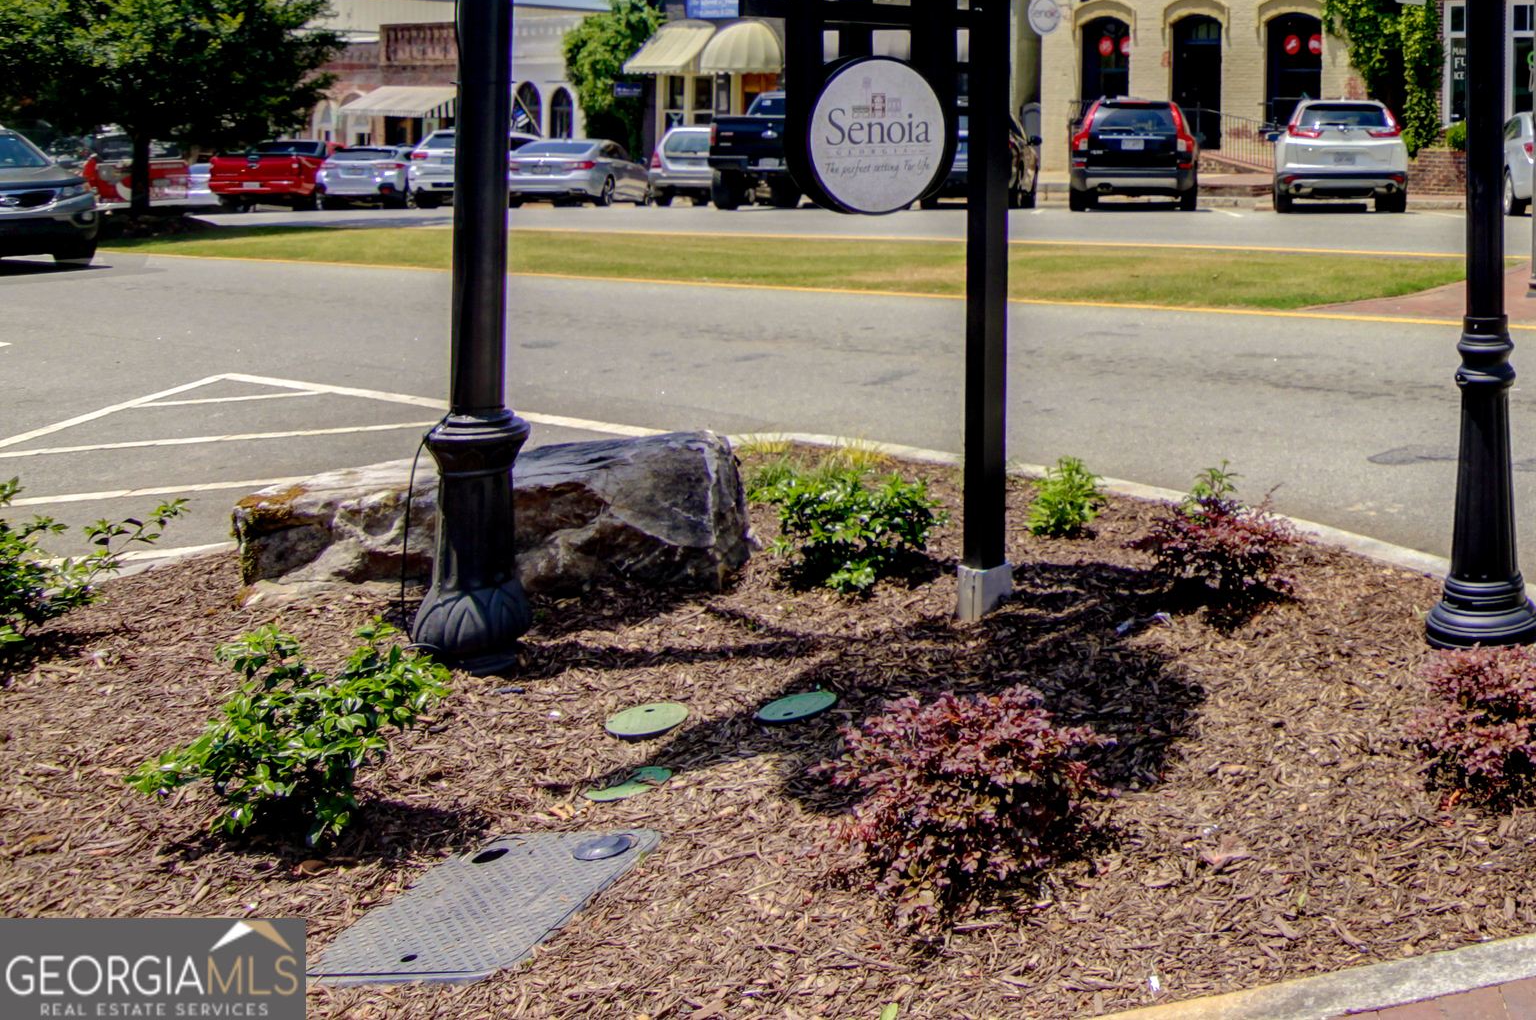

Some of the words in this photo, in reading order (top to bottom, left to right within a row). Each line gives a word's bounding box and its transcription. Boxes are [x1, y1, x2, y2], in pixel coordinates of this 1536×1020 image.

[826, 108, 932, 146] Senoia
[836, 147, 908, 156] GEORGIA
[825, 162, 839, 174] The
[841, 159, 871, 179] perfect
[873, 163, 900, 179] setting
[917, 157, 930, 176] life
